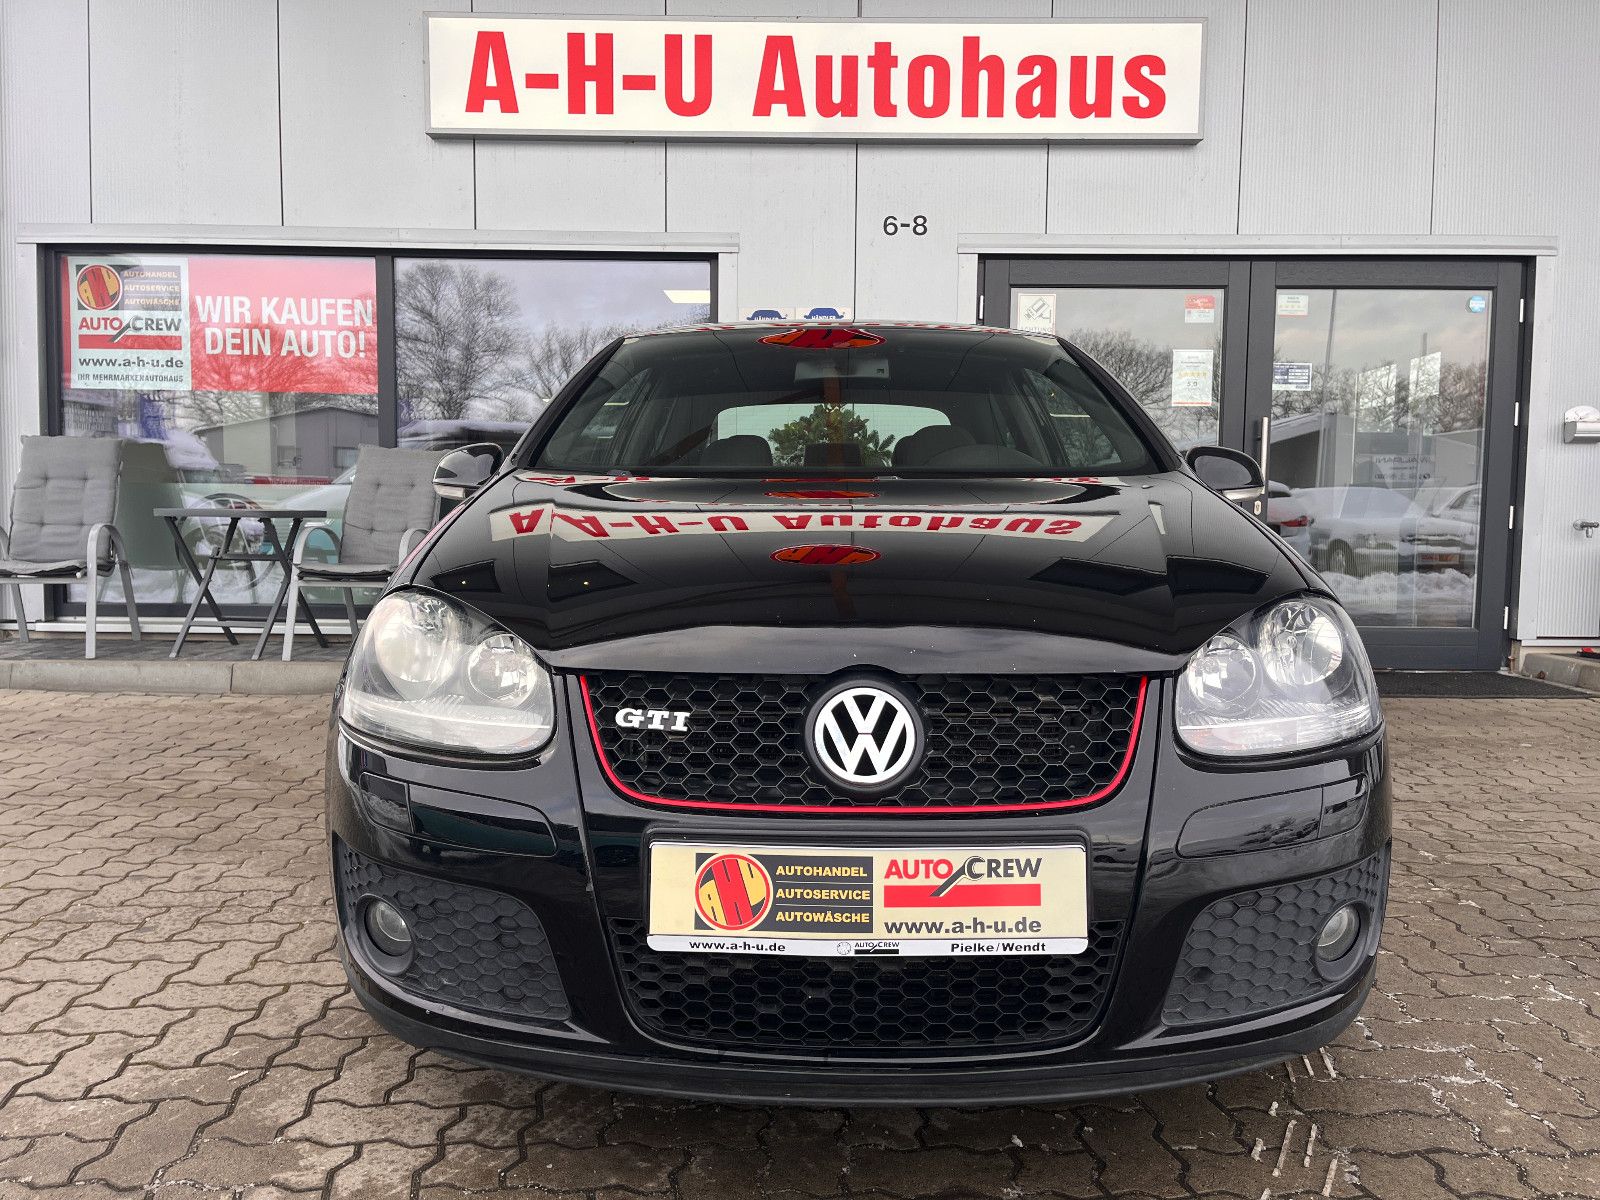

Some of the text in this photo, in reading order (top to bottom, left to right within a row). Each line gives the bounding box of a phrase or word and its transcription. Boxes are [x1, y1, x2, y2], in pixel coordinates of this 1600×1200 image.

[464, 31, 1166, 119] A-H-U Autohaus
[883, 215, 928, 236] 6-8
[123, 270, 178, 279] AUTOHANDEL
[123, 284, 181, 292] AUTOSERVICE
[195, 295, 374, 327] WIR KAUFEN
[79, 316, 182, 332] AUTO CREW
[204, 327, 367, 359] DEIN AUTO!
[78, 356, 185, 368] www.a-h-u.de
[77, 373, 184, 383] IHR MEHRMARKENAUTOHAUS
[614, 707, 691, 732] GTI
[775, 865, 868, 877] AUTOHANDEL
[884, 856, 1042, 880] AUTO CREW
[775, 887, 871, 900] AUTOSERVICE
[775, 910, 870, 923] AUTOWÄSCHE
[884, 917, 1042, 934] www.a-h-u.de
[688, 940, 786, 952] www.a-h-u.de
